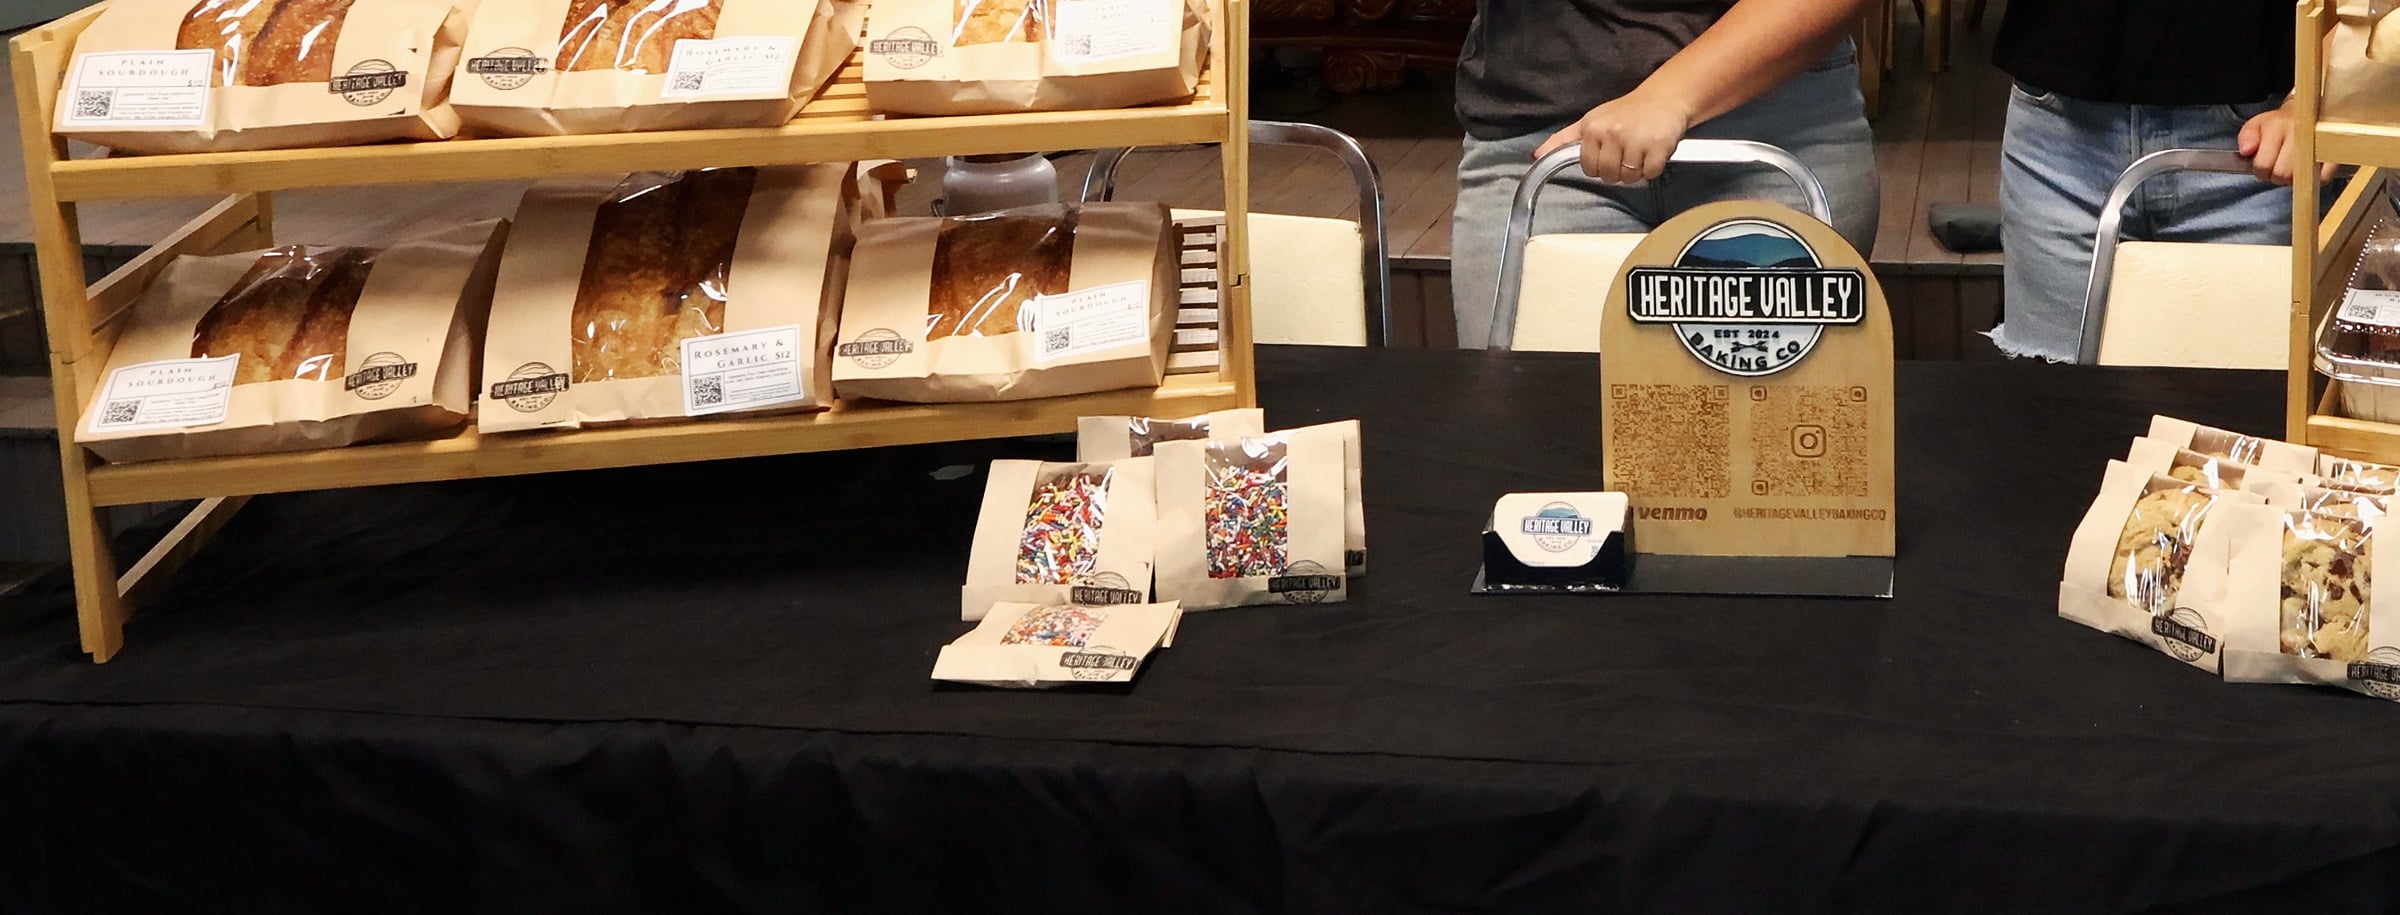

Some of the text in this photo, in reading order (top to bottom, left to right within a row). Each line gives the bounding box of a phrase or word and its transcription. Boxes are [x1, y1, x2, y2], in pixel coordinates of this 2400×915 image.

[98, 68, 190, 76] SOURDOUGH
[1640, 275, 1852, 318] HERITAGE VALLEY
[1714, 329, 1780, 339] EST 2024
[694, 339, 783, 359] ROSEMARY &
[843, 340, 911, 355] HERITAGE VALLEY
[1690, 332, 1801, 369] BAKING CO
[717, 350, 791, 368] GARLIC $12
[150, 367, 193, 376] PLAIN
[382, 364, 413, 380] VALLEY
[127, 375, 217, 388] SOURDOUGH
[494, 380, 533, 397] HERITAGE
[1638, 507, 1708, 520] venmo
[1733, 507, 1887, 521] @HERITAGEVALLEYBAKINGCO
[1524, 519, 1590, 534] HERITAGE VALLEY
[1074, 588, 1109, 602] HERITAGE
[1064, 654, 1102, 667] HERITAGE
[2351, 665, 2389, 681] HERITAGE
